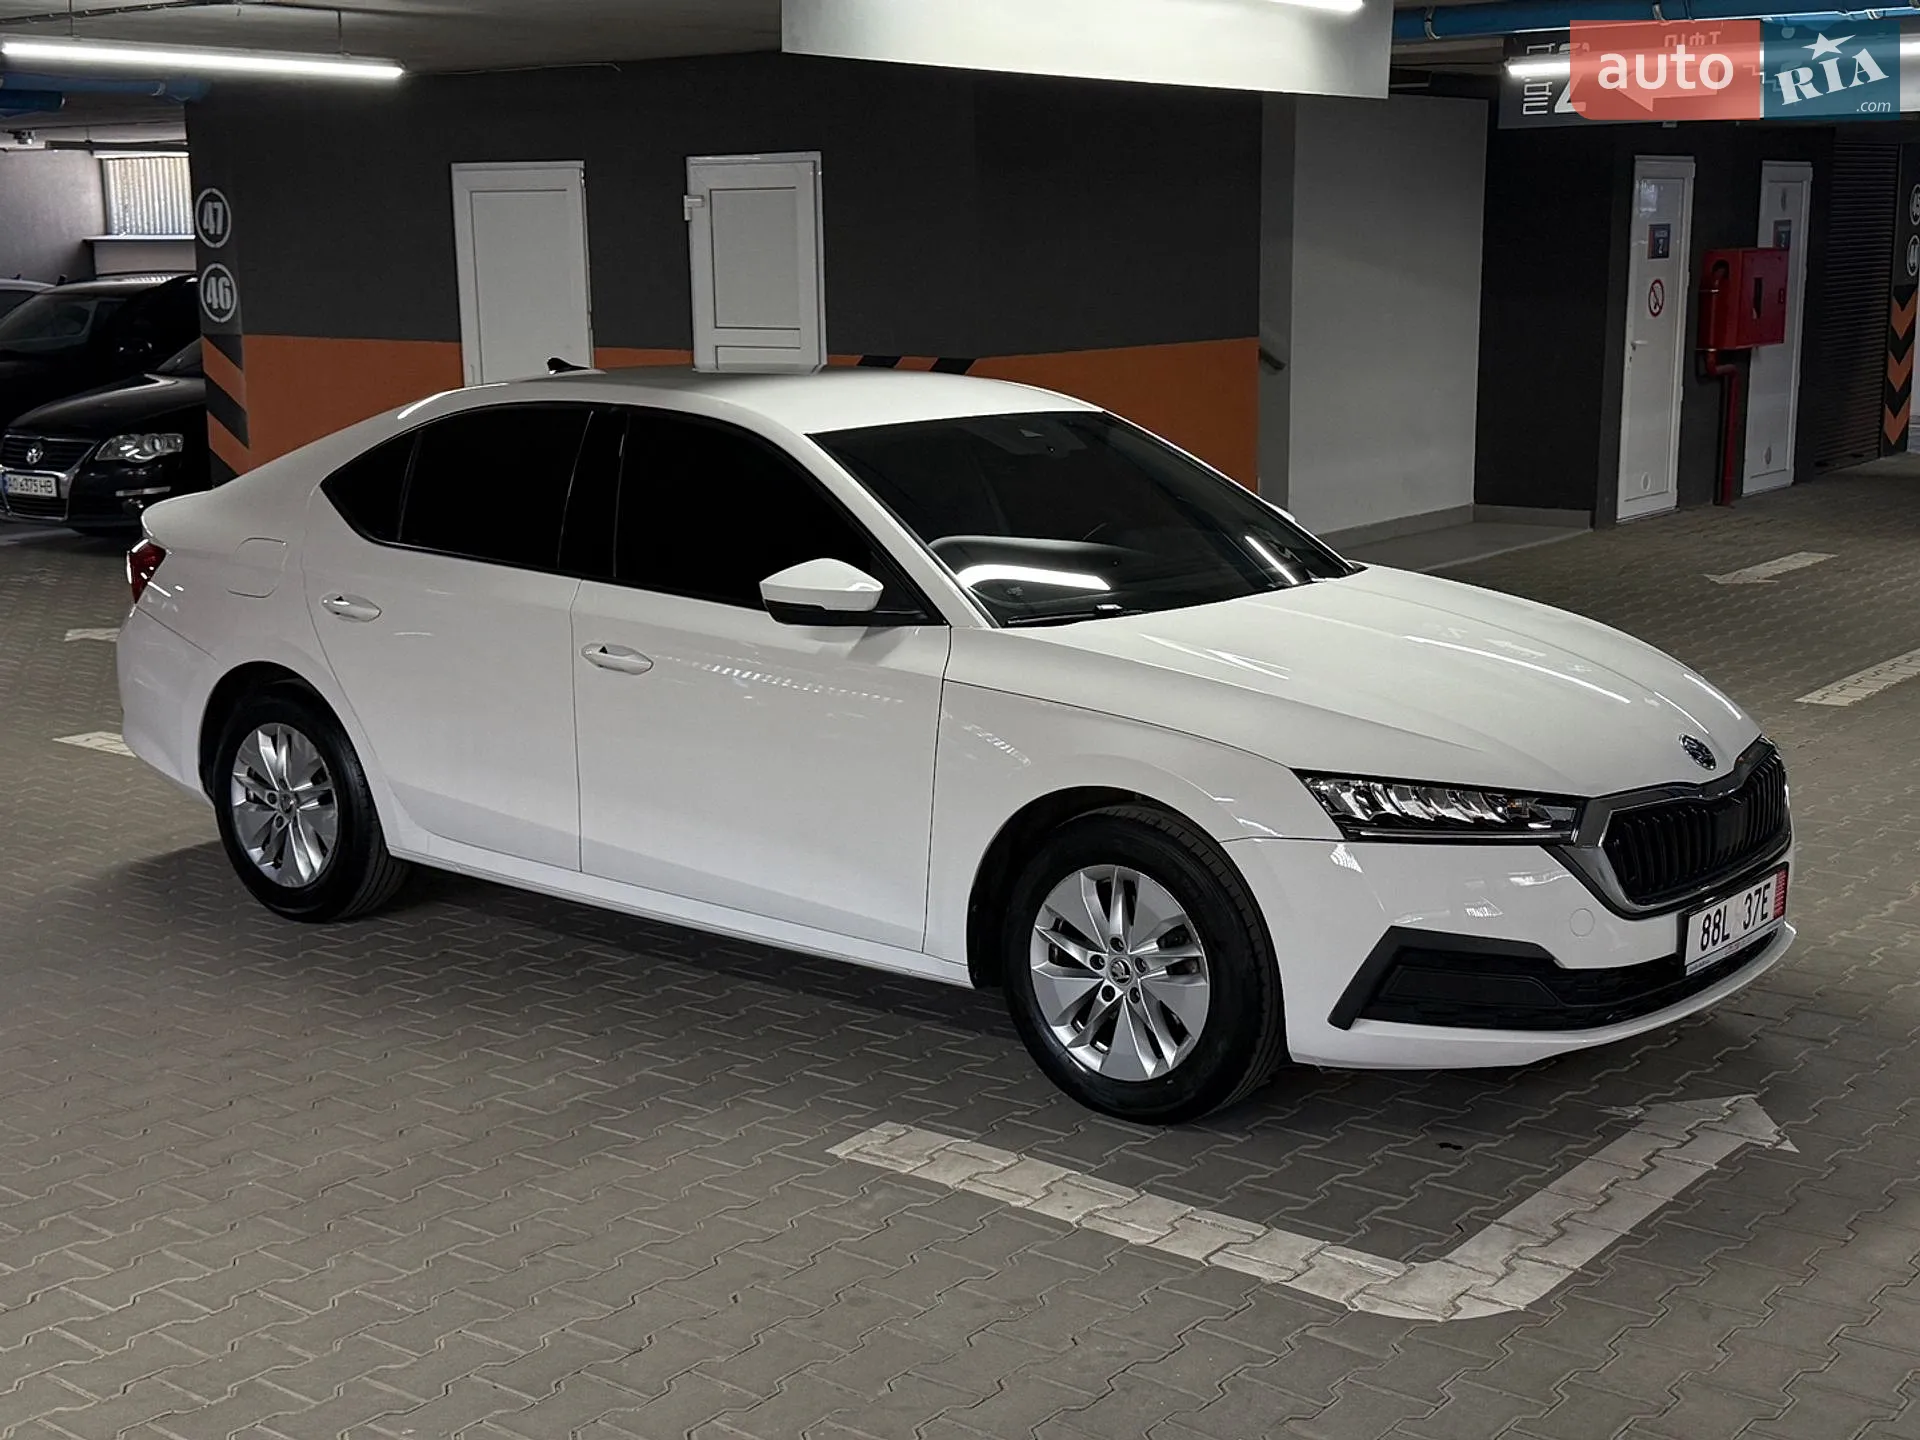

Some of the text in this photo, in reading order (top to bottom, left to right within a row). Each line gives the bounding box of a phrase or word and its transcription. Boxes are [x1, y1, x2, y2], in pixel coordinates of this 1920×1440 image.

[202, 201, 224, 235] 47
[206, 276, 232, 310] 46
[1701, 905, 1730, 951] 88L
[1743, 882, 1771, 930] 37E
